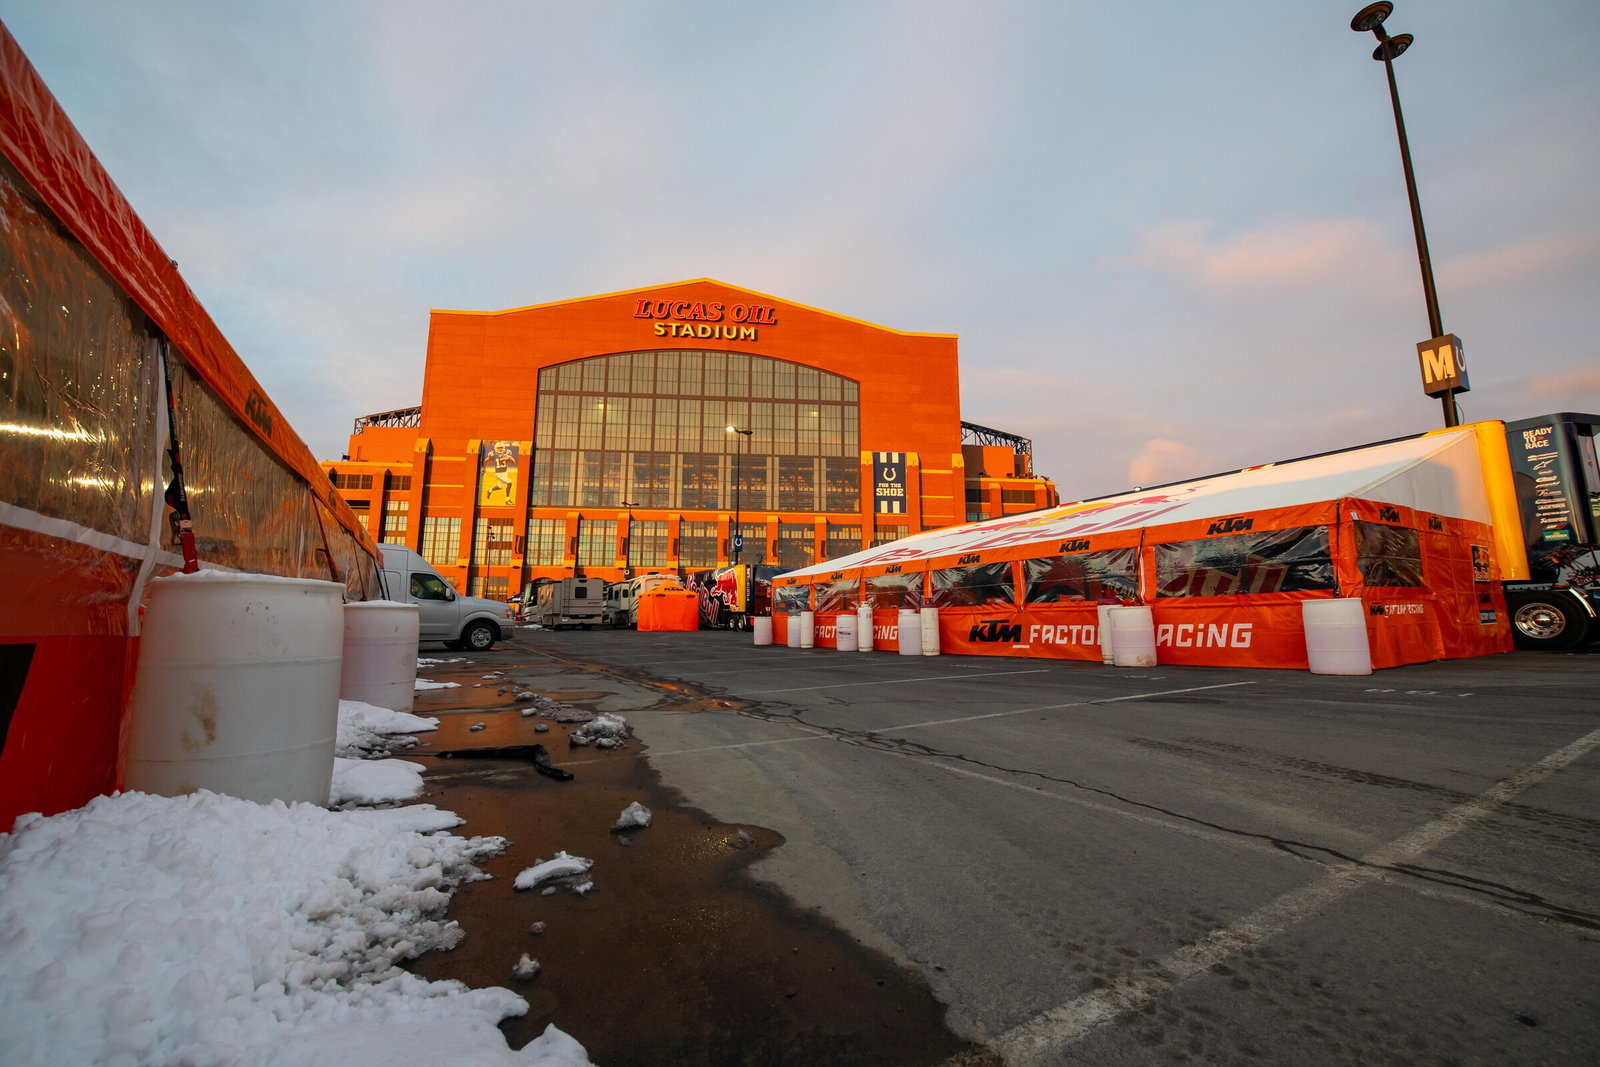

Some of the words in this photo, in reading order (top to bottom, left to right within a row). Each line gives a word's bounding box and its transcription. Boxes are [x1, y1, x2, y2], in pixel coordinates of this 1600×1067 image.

[634, 299, 723, 322] LUCAS
[729, 304, 776, 324] OIL
[654, 322, 756, 340] STADIUM
[1421, 344, 1456, 384] M
[1522, 427, 1553, 438] READY
[1525, 439, 1550, 450] RACE
[495, 458, 507, 468] 13
[876, 488, 904, 497] SHOE
[1379, 506, 1400, 522] KTM
[1207, 516, 1254, 535] KTM
[1058, 538, 1091, 553] KTM
[957, 553, 981, 565] KTM
[885, 564, 902, 573] KTM
[814, 626, 837, 638] FACT
[968, 620, 1022, 642] KTM
[1029, 625, 1100, 645] FACTO
